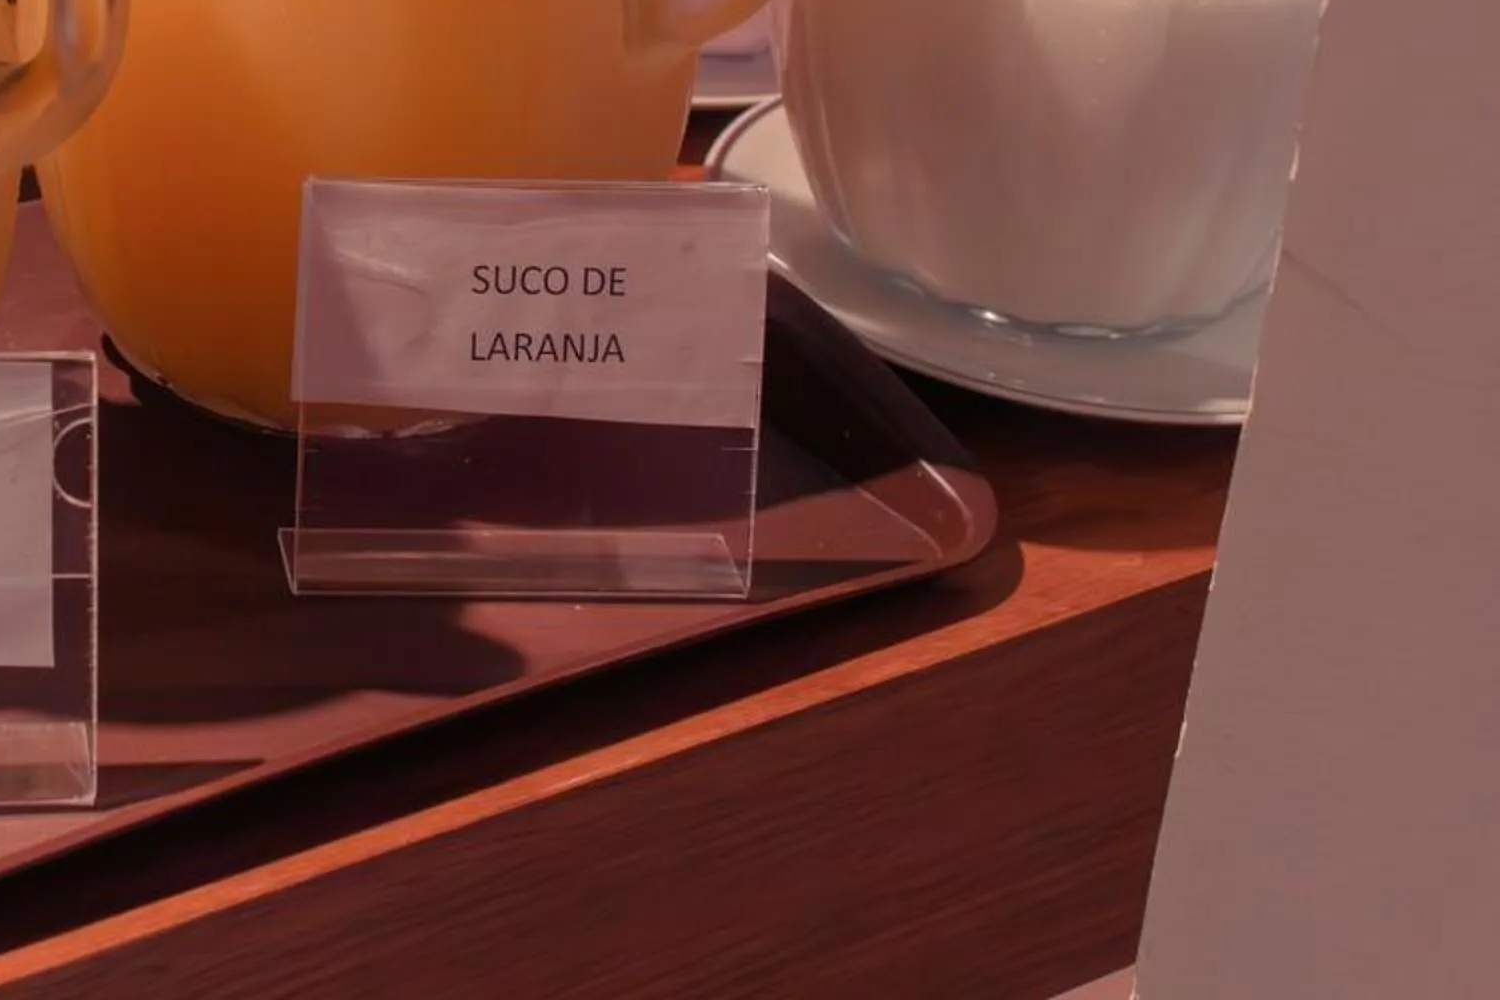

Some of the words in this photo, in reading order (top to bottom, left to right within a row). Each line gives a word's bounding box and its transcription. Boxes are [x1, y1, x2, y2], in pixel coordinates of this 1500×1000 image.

[471, 264, 570, 296] SUCO
[582, 266, 627, 297] DE
[470, 331, 626, 363] LARANJA
